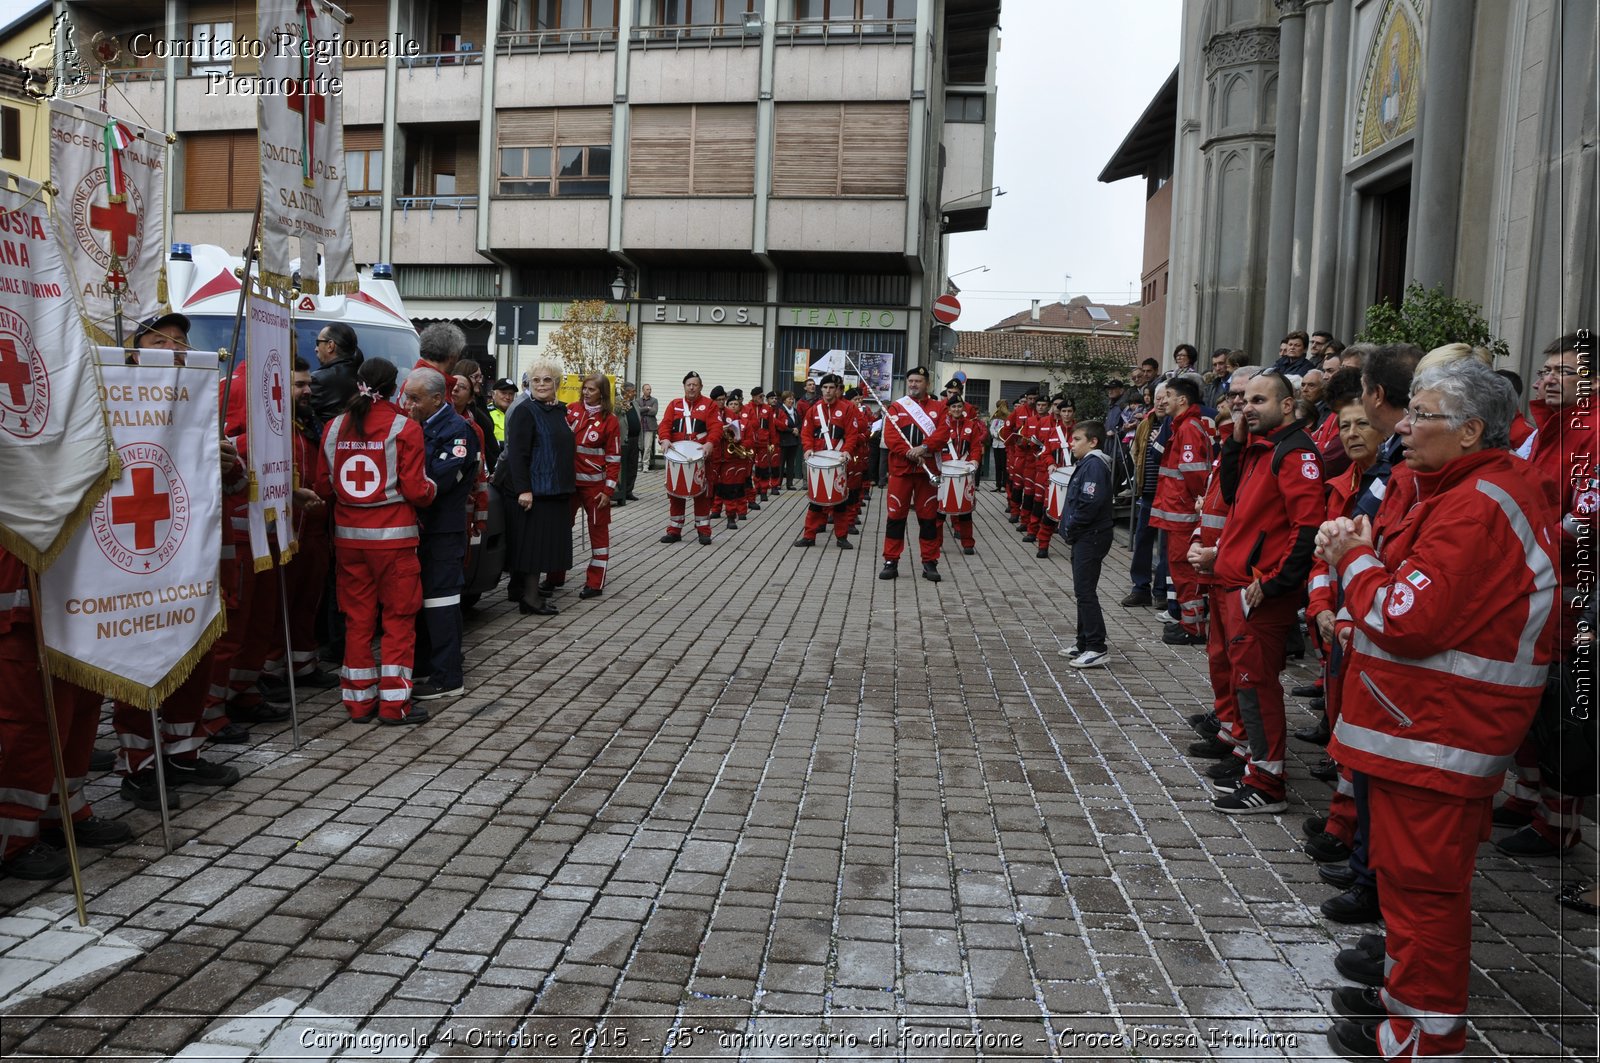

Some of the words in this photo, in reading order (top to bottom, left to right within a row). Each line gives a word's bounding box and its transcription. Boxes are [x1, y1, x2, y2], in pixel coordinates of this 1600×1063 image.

[91, 139, 125, 161] ROA
[655, 304, 748, 323] ELIOS
[791, 308, 895, 327] TEATRO
[97, 385, 134, 402] OCE
[138, 385, 189, 402] ROSSA
[103, 410, 174, 427] TALIANA
[169, 478, 186, 532] AGOSTO
[158, 536, 178, 563] 1864
[65, 590, 154, 615] COMITATO
[158, 580, 213, 604] LOCALE
[96, 607, 196, 640] NICHELINO
